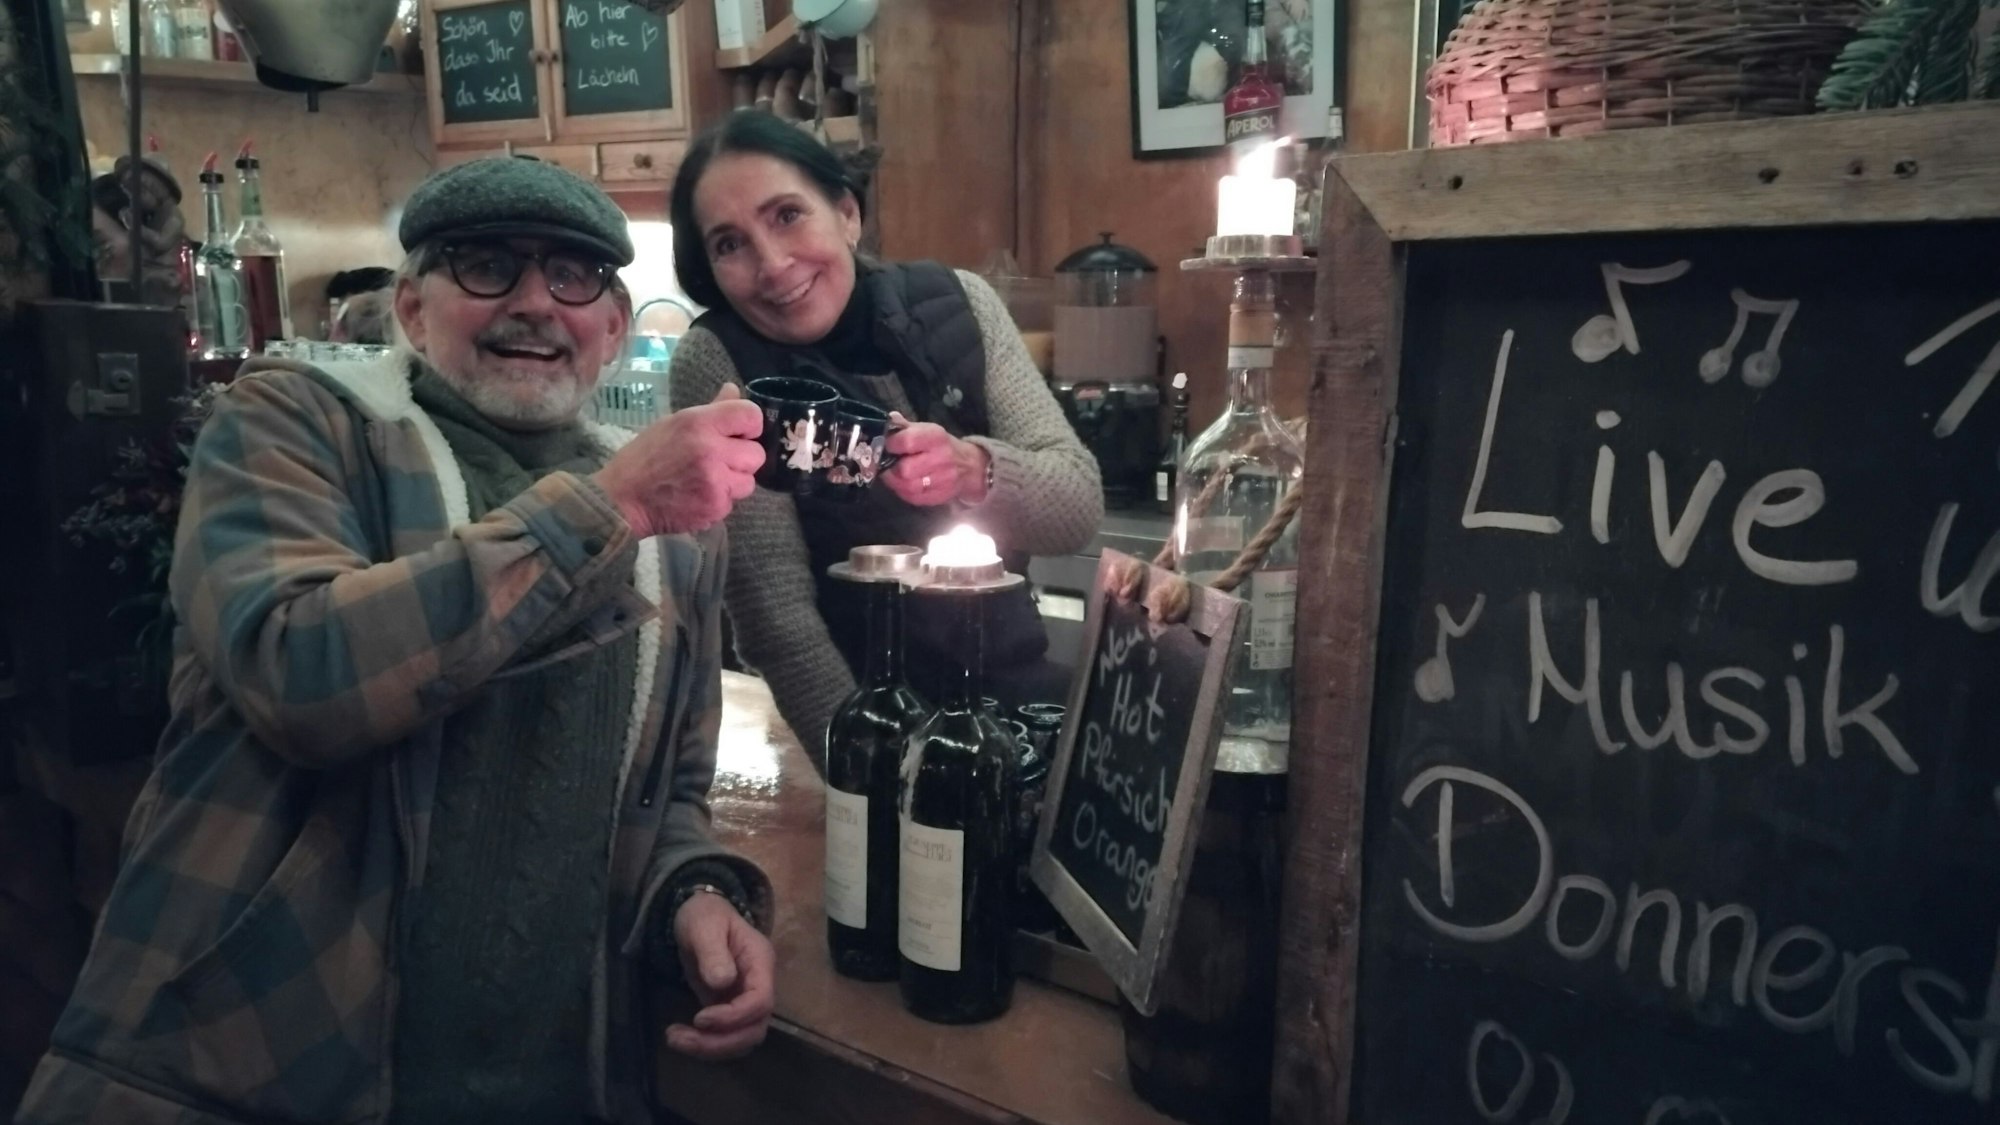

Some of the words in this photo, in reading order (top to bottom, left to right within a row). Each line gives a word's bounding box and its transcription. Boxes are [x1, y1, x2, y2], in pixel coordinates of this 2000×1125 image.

[441, 16, 489, 42] Schön
[566, 4, 589, 29] Ab
[599, 2, 633, 24] hier
[590, 29, 630, 50] bitte
[444, 47, 480, 72] dass
[456, 80, 477, 108] da
[483, 73, 523, 103] seid
[1227, 115, 1275, 138] APEROL
[1462, 328, 1859, 585] Live
[1526, 590, 1919, 775] Musik
[1110, 672, 1165, 743] Hot
[1081, 721, 1173, 833] Pfirsich
